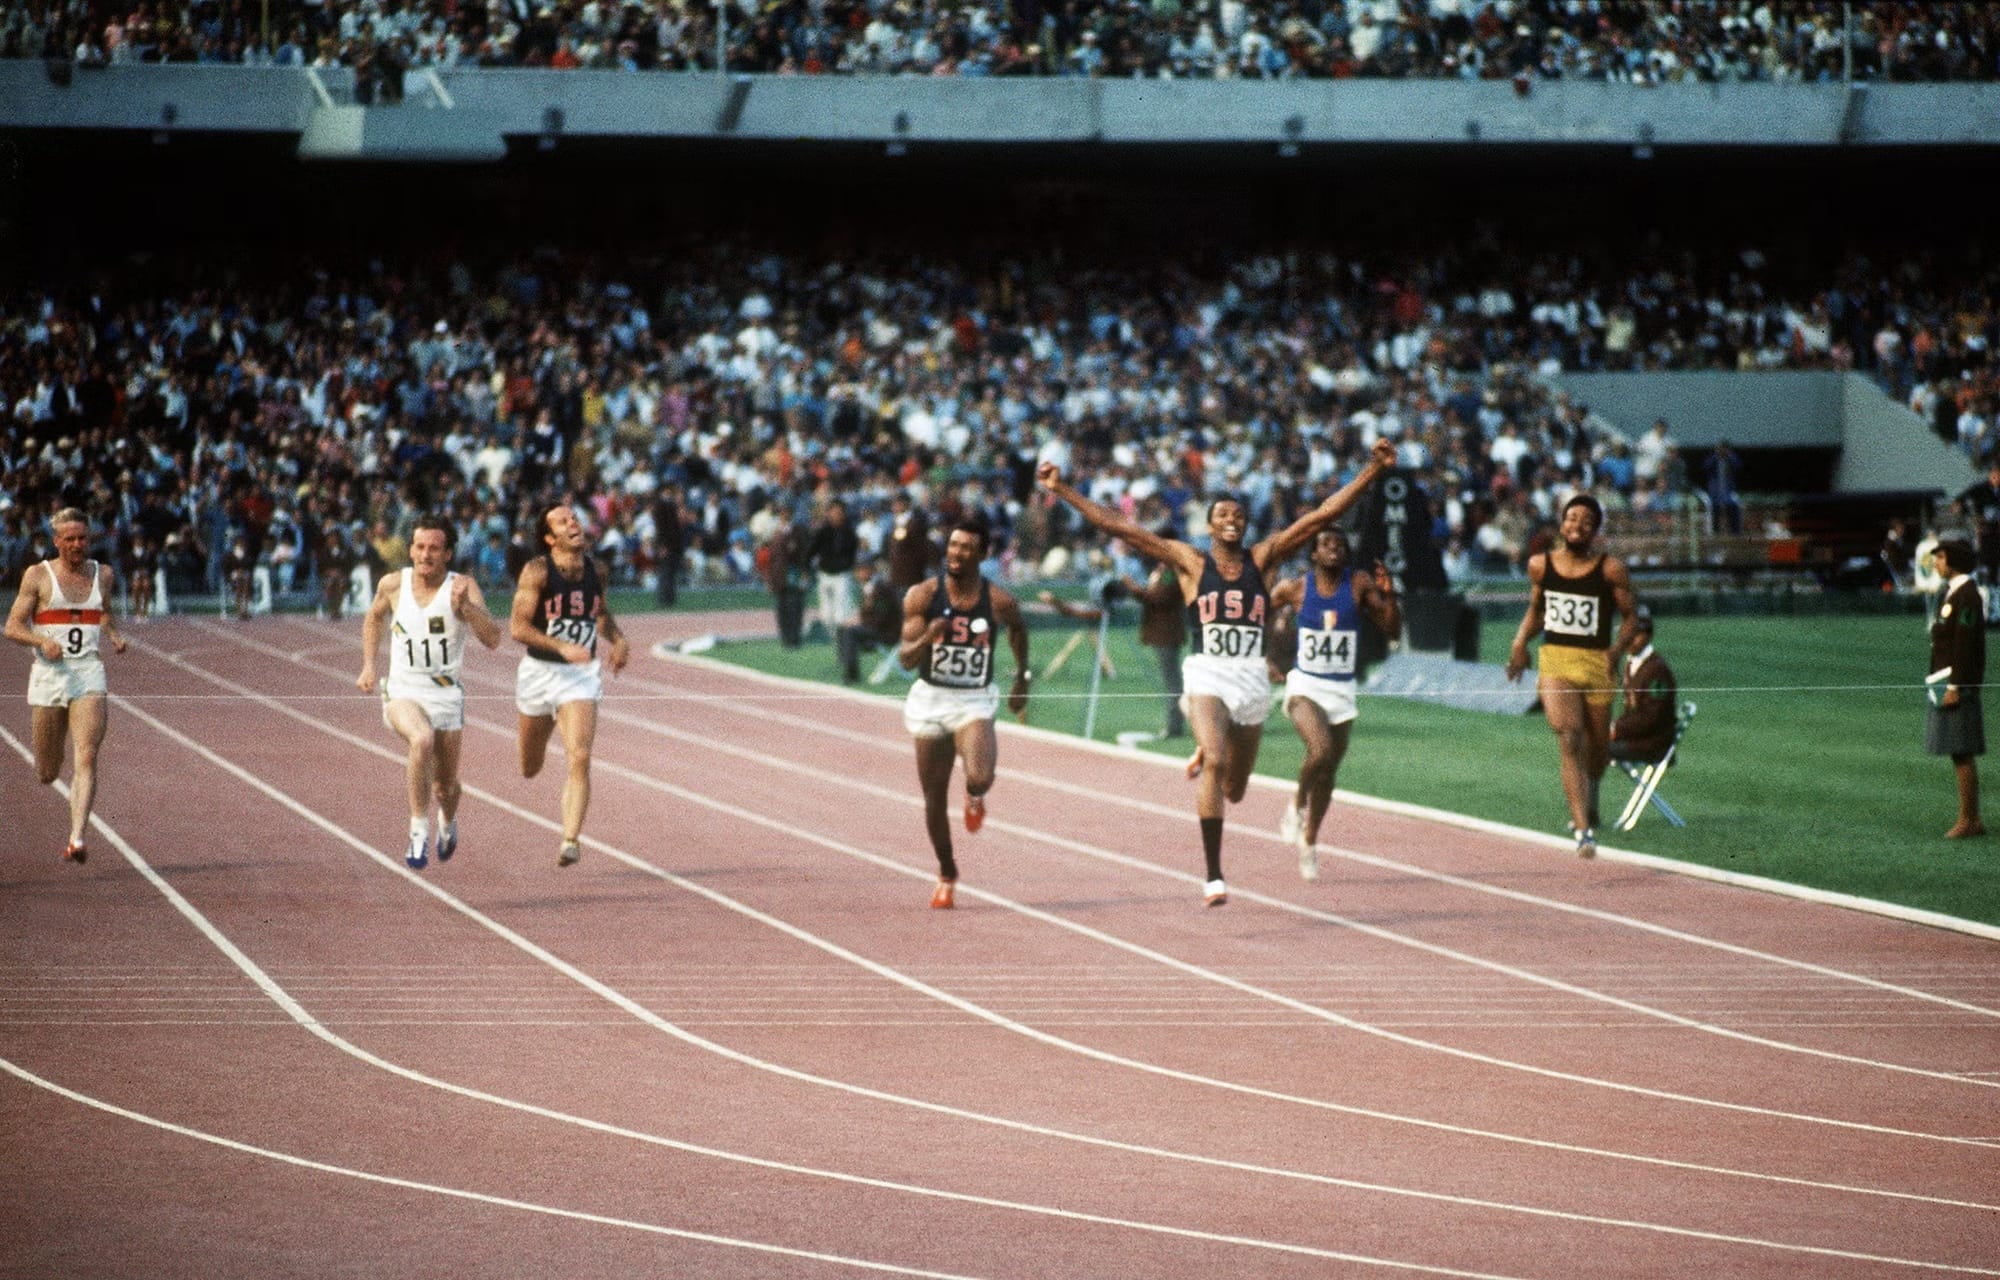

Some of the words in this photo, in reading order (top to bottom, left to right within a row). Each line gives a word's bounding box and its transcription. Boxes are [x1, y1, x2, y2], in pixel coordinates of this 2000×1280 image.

[1198, 590, 1266, 625] USA
[1548, 596, 1594, 628] 533
[67, 627, 83, 654] 9
[551, 619, 595, 646] 297
[1208, 628, 1260, 657] 307
[405, 637, 450, 667] 111
[934, 646, 984, 677] 259
[1304, 635, 1349, 663] 344
